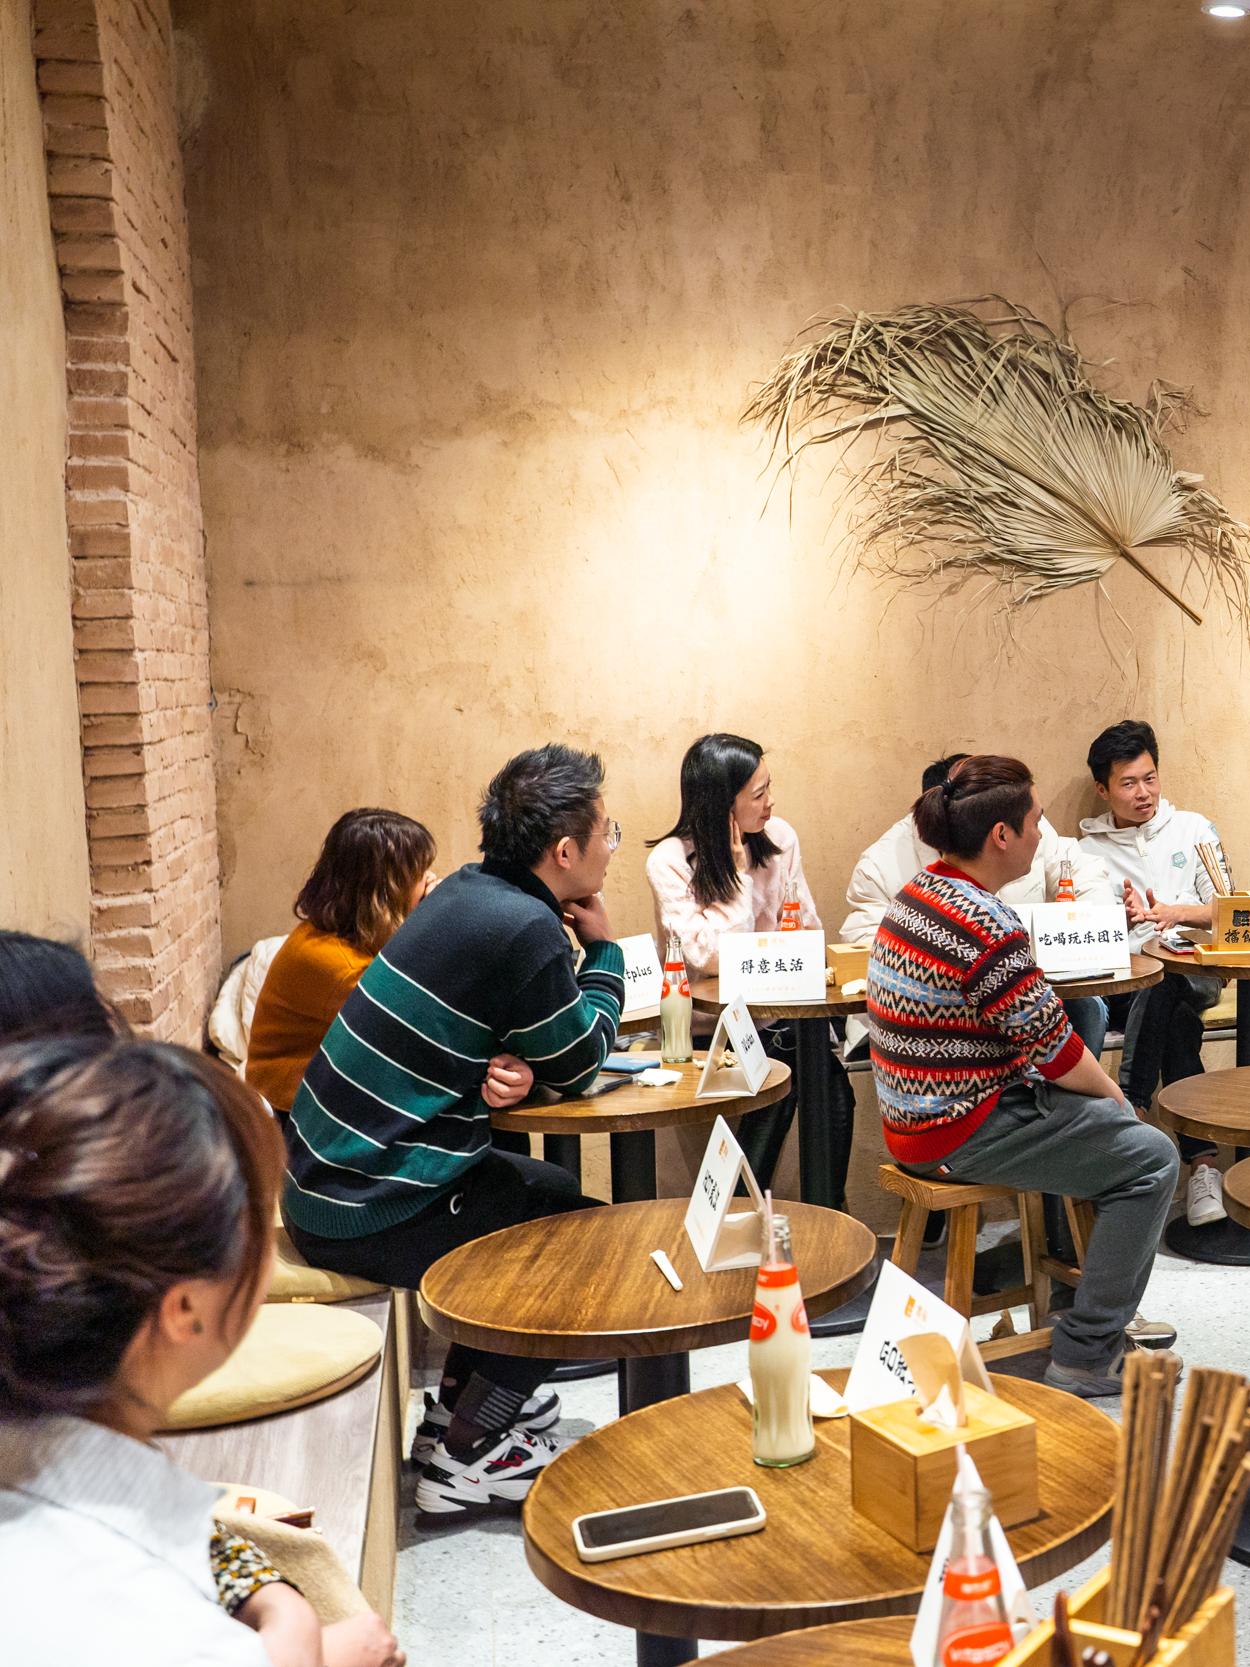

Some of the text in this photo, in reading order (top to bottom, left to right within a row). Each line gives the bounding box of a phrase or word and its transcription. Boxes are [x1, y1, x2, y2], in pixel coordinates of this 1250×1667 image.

[1038, 930, 1124, 946] 吃喝玩乐团长
[741, 958, 804, 974] 得意生活
[623, 966, 652, 983] tplus
